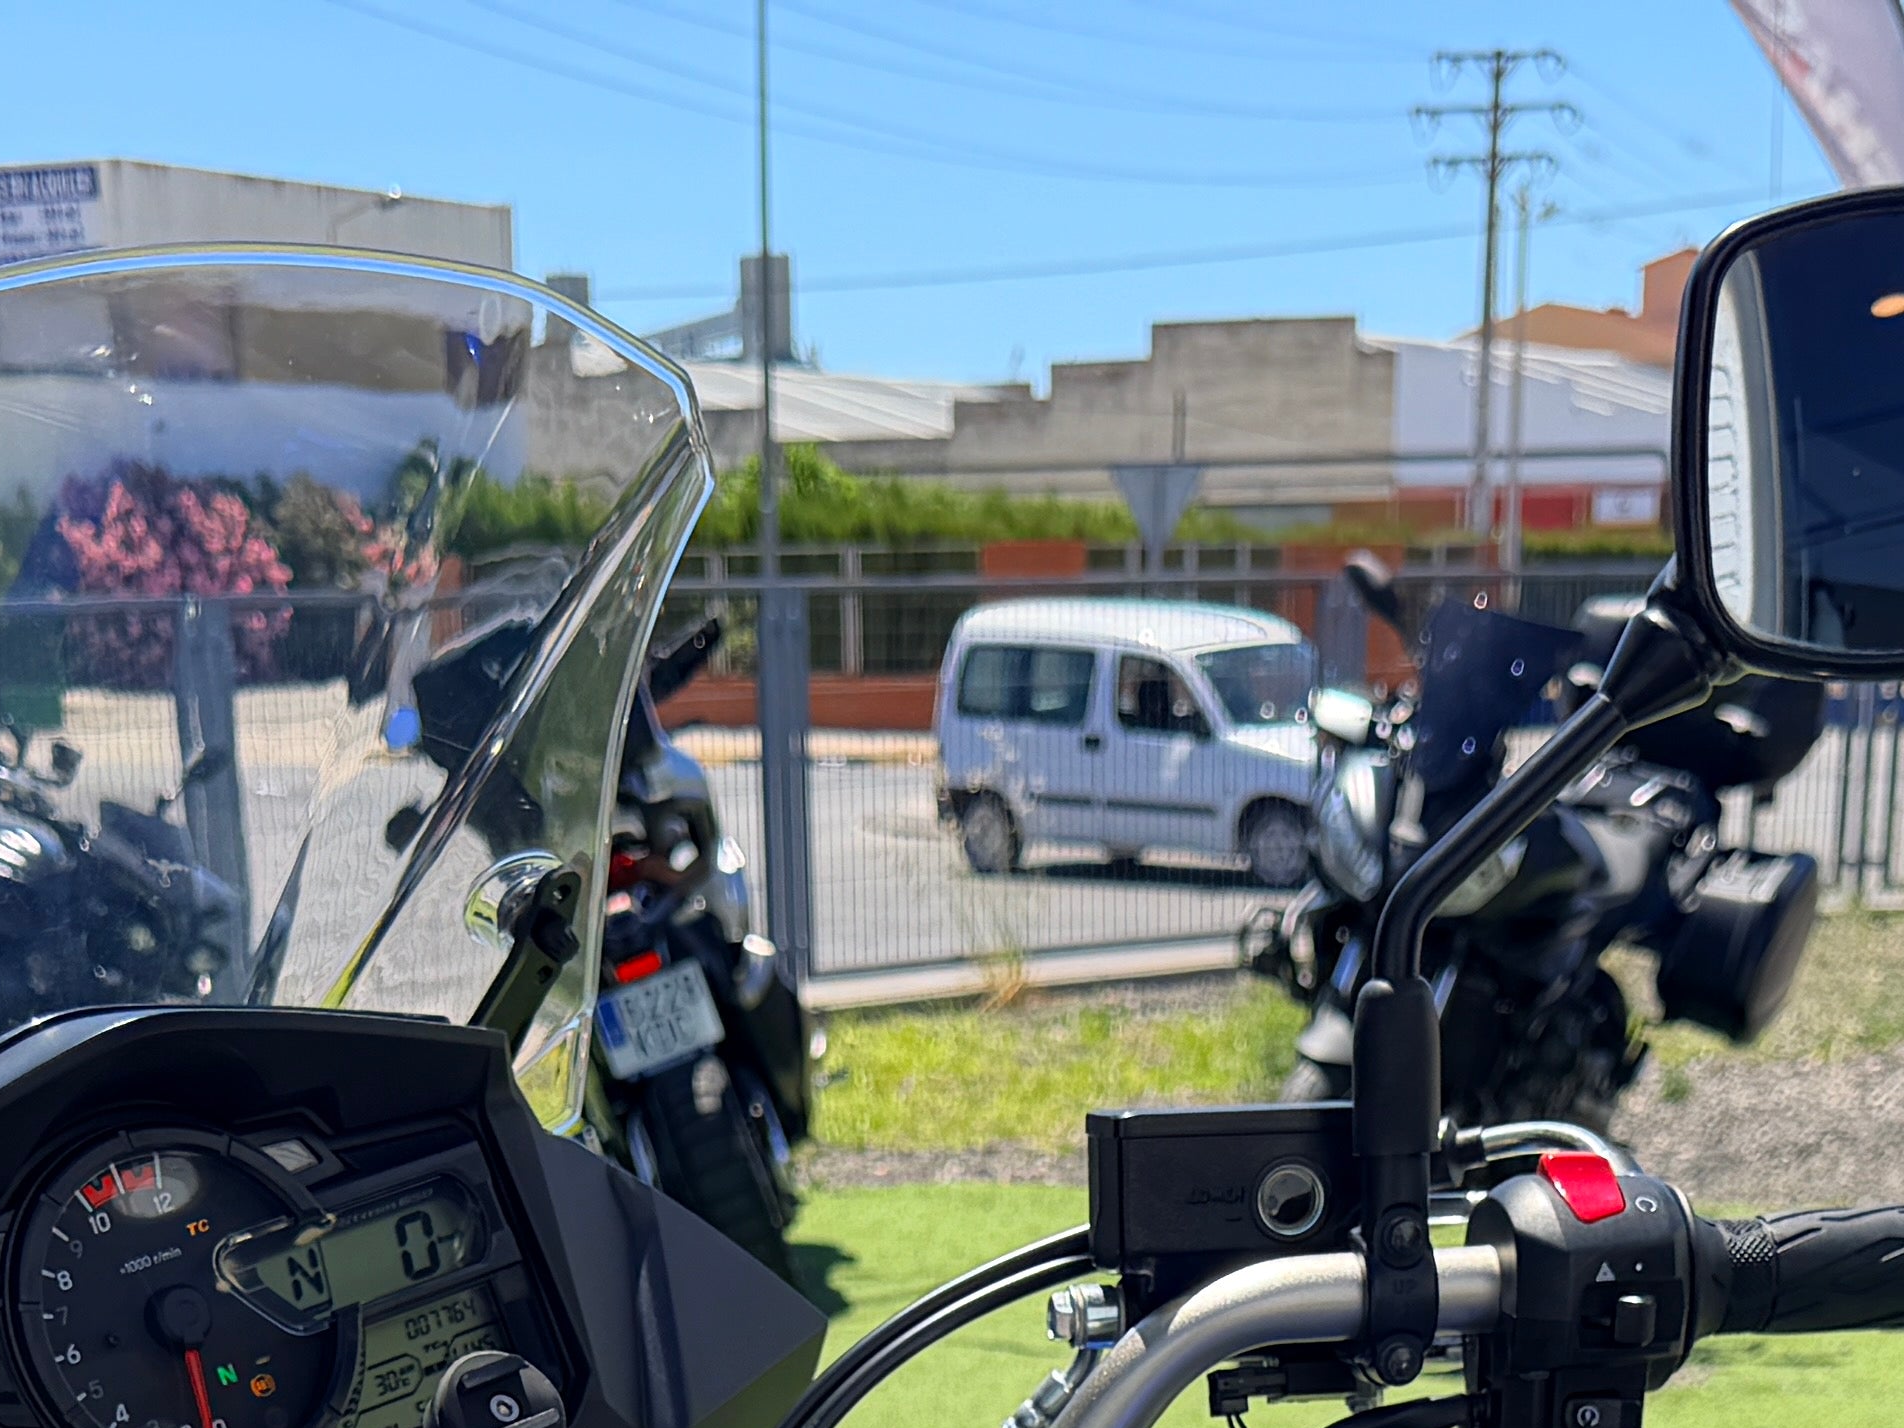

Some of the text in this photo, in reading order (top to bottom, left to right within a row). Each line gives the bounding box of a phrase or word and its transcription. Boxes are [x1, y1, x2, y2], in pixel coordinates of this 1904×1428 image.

[153, 1192, 172, 1214] 12
[88, 1212, 111, 1234] 10
[186, 1218, 210, 1236] TC
[69, 1239, 83, 1258] 9
[395, 1210, 441, 1281] 0
[56, 1270, 73, 1291] 8
[287, 1247, 324, 1301] N
[55, 1305, 69, 1326] 7
[66, 1344, 81, 1364] 6
[217, 1363, 238, 1385] N
[88, 1380, 104, 1399] 5
[116, 1403, 130, 1423] 4
